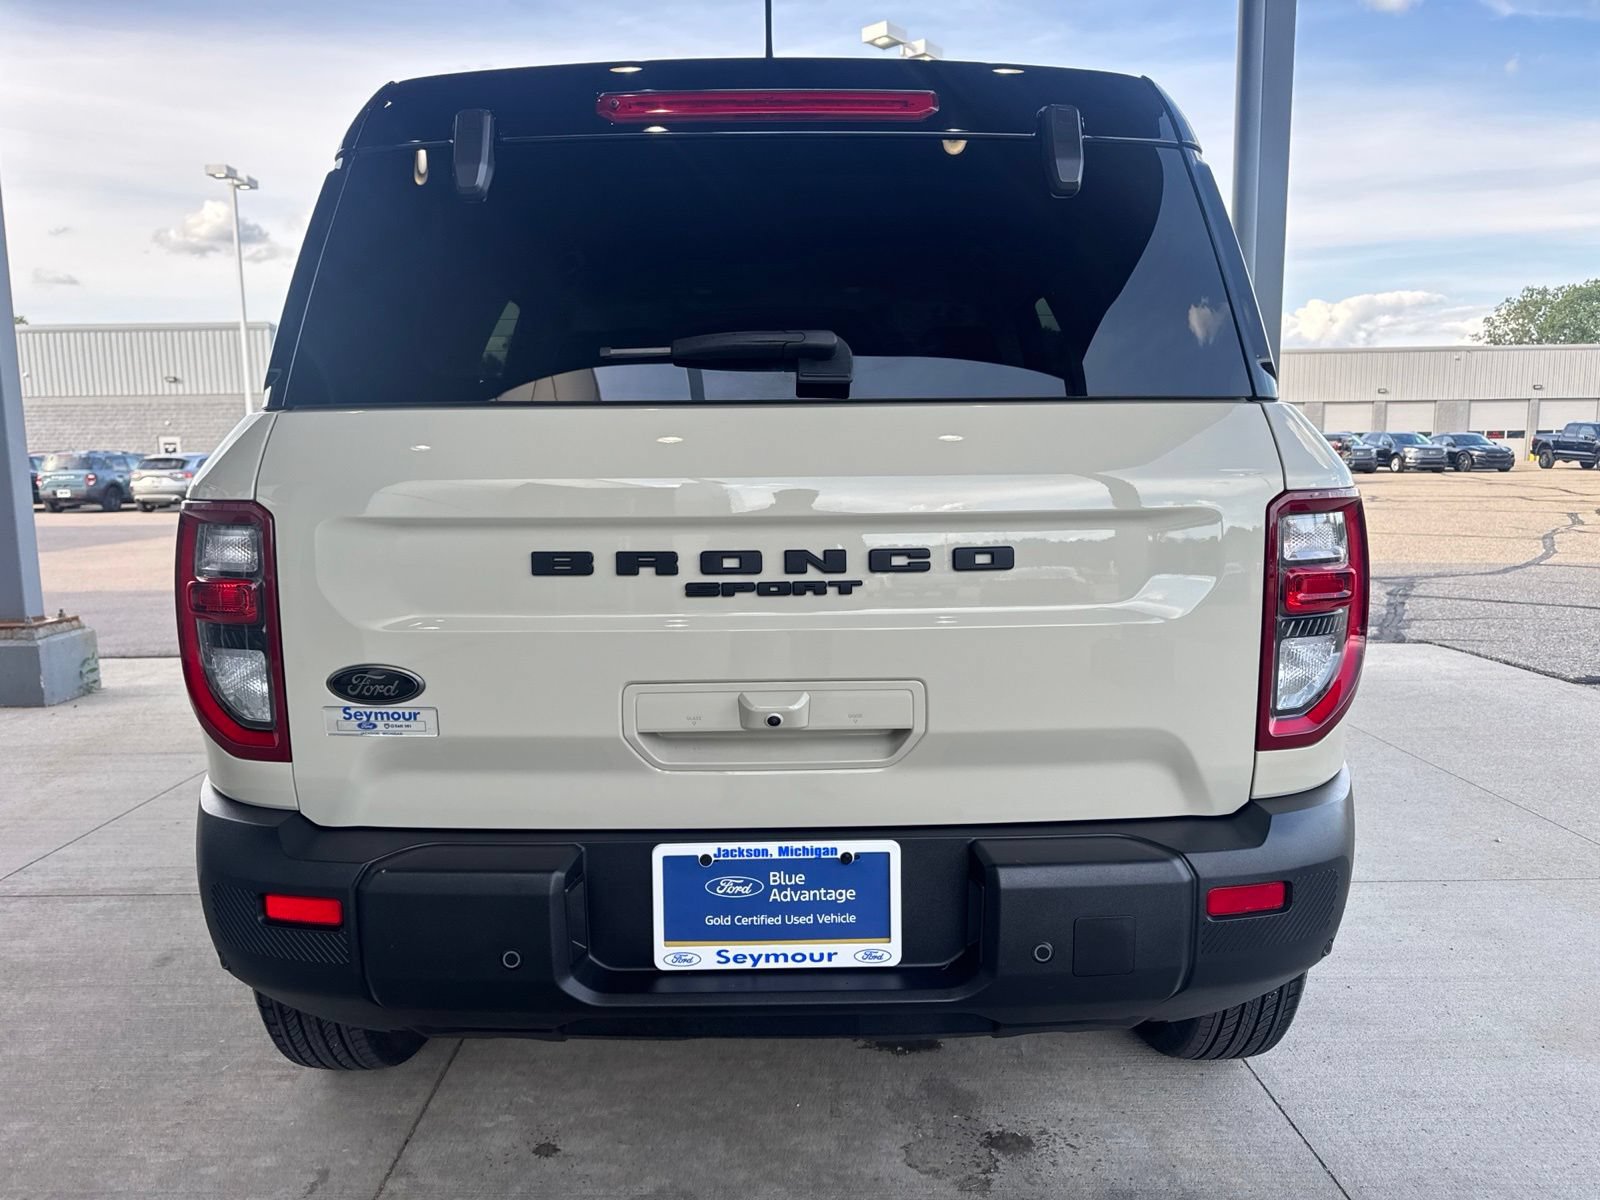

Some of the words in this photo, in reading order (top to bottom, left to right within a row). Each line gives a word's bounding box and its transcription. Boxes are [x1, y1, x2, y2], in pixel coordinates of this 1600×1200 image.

[531, 545, 1015, 576] BRONCO
[685, 580, 863, 598] SPORT
[347, 673, 399, 696] Ford
[342, 706, 420, 723] Seymour
[713, 847, 773, 859] Jackson,
[778, 846, 838, 858] Michigan
[769, 871, 805, 886] Blue
[716, 879, 753, 895] Ford
[769, 887, 856, 903] Advantage
[705, 915, 731, 925] Gold
[734, 914, 782, 925] Certified
[785, 914, 813, 924] Used
[816, 913, 857, 924] Vehicle
[671, 954, 694, 964] Ford
[716, 949, 838, 967] Seymour
[861, 951, 884, 961] Ford
